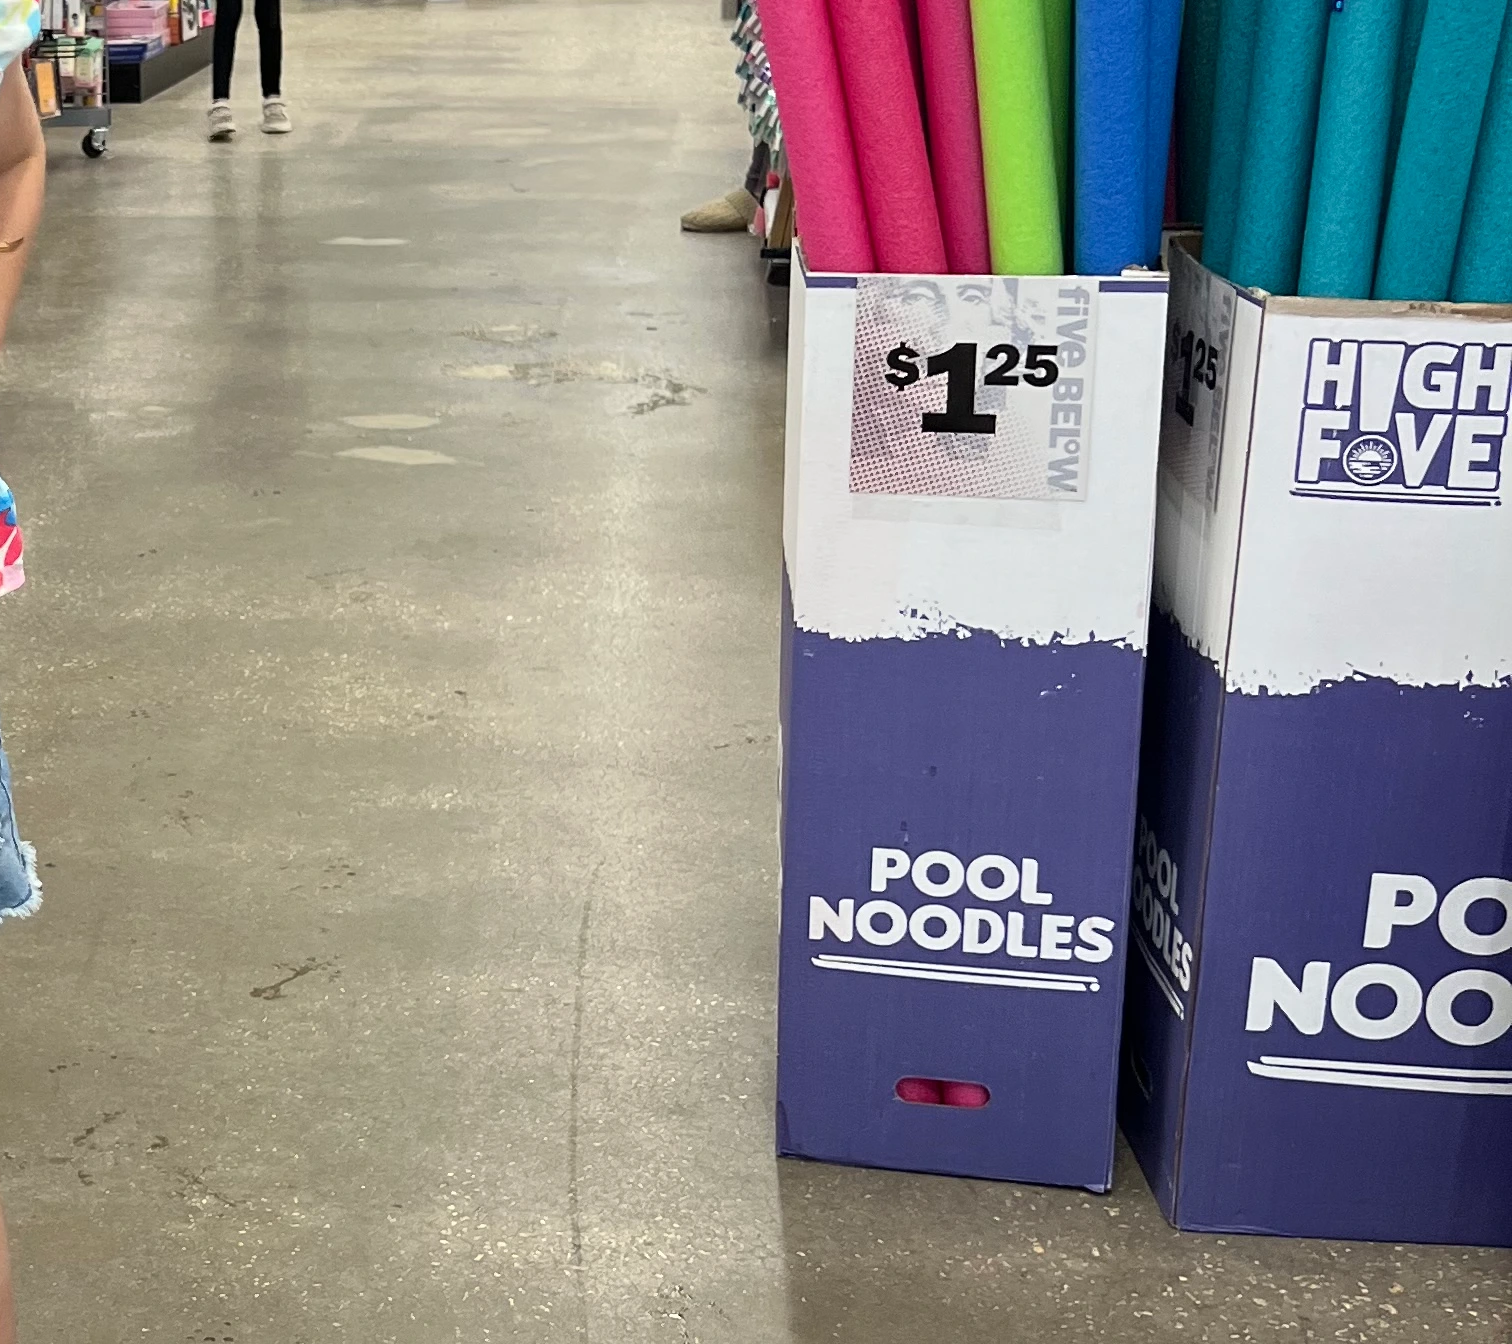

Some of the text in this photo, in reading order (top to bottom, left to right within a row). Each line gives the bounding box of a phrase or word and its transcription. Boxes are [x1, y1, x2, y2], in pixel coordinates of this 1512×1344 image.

[883, 340, 1061, 436] $125
[870, 846, 1054, 907] POOL
[807, 895, 1116, 965] NOODLES
